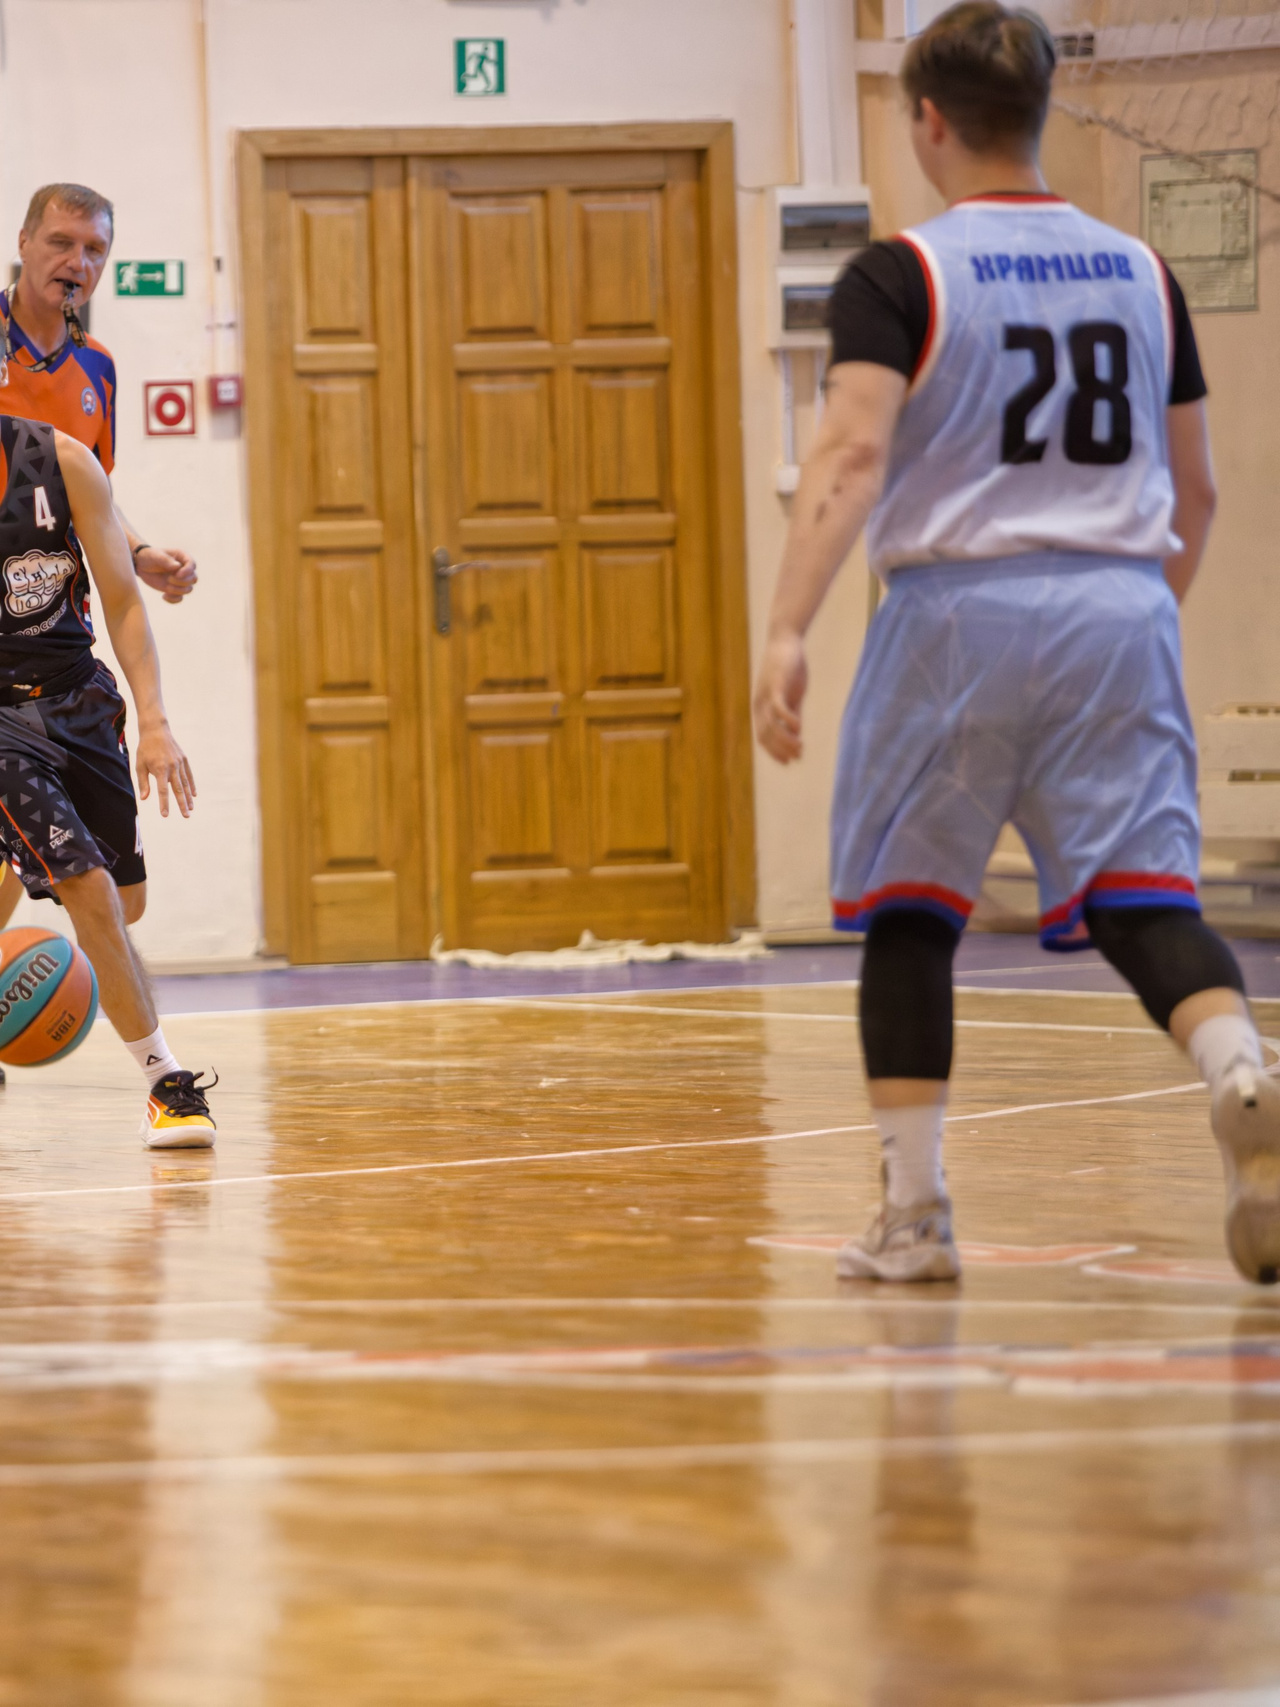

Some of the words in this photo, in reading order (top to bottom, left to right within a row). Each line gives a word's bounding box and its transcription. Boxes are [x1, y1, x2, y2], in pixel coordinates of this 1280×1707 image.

[970, 252, 1135, 283] ХРАМЦОВ
[1002, 322, 1132, 464] 28
[33, 485, 57, 532] 4
[28, 685, 42, 697] 4
[49, 828, 72, 850] PEAK
[50, 1012, 77, 1042] FIBA
